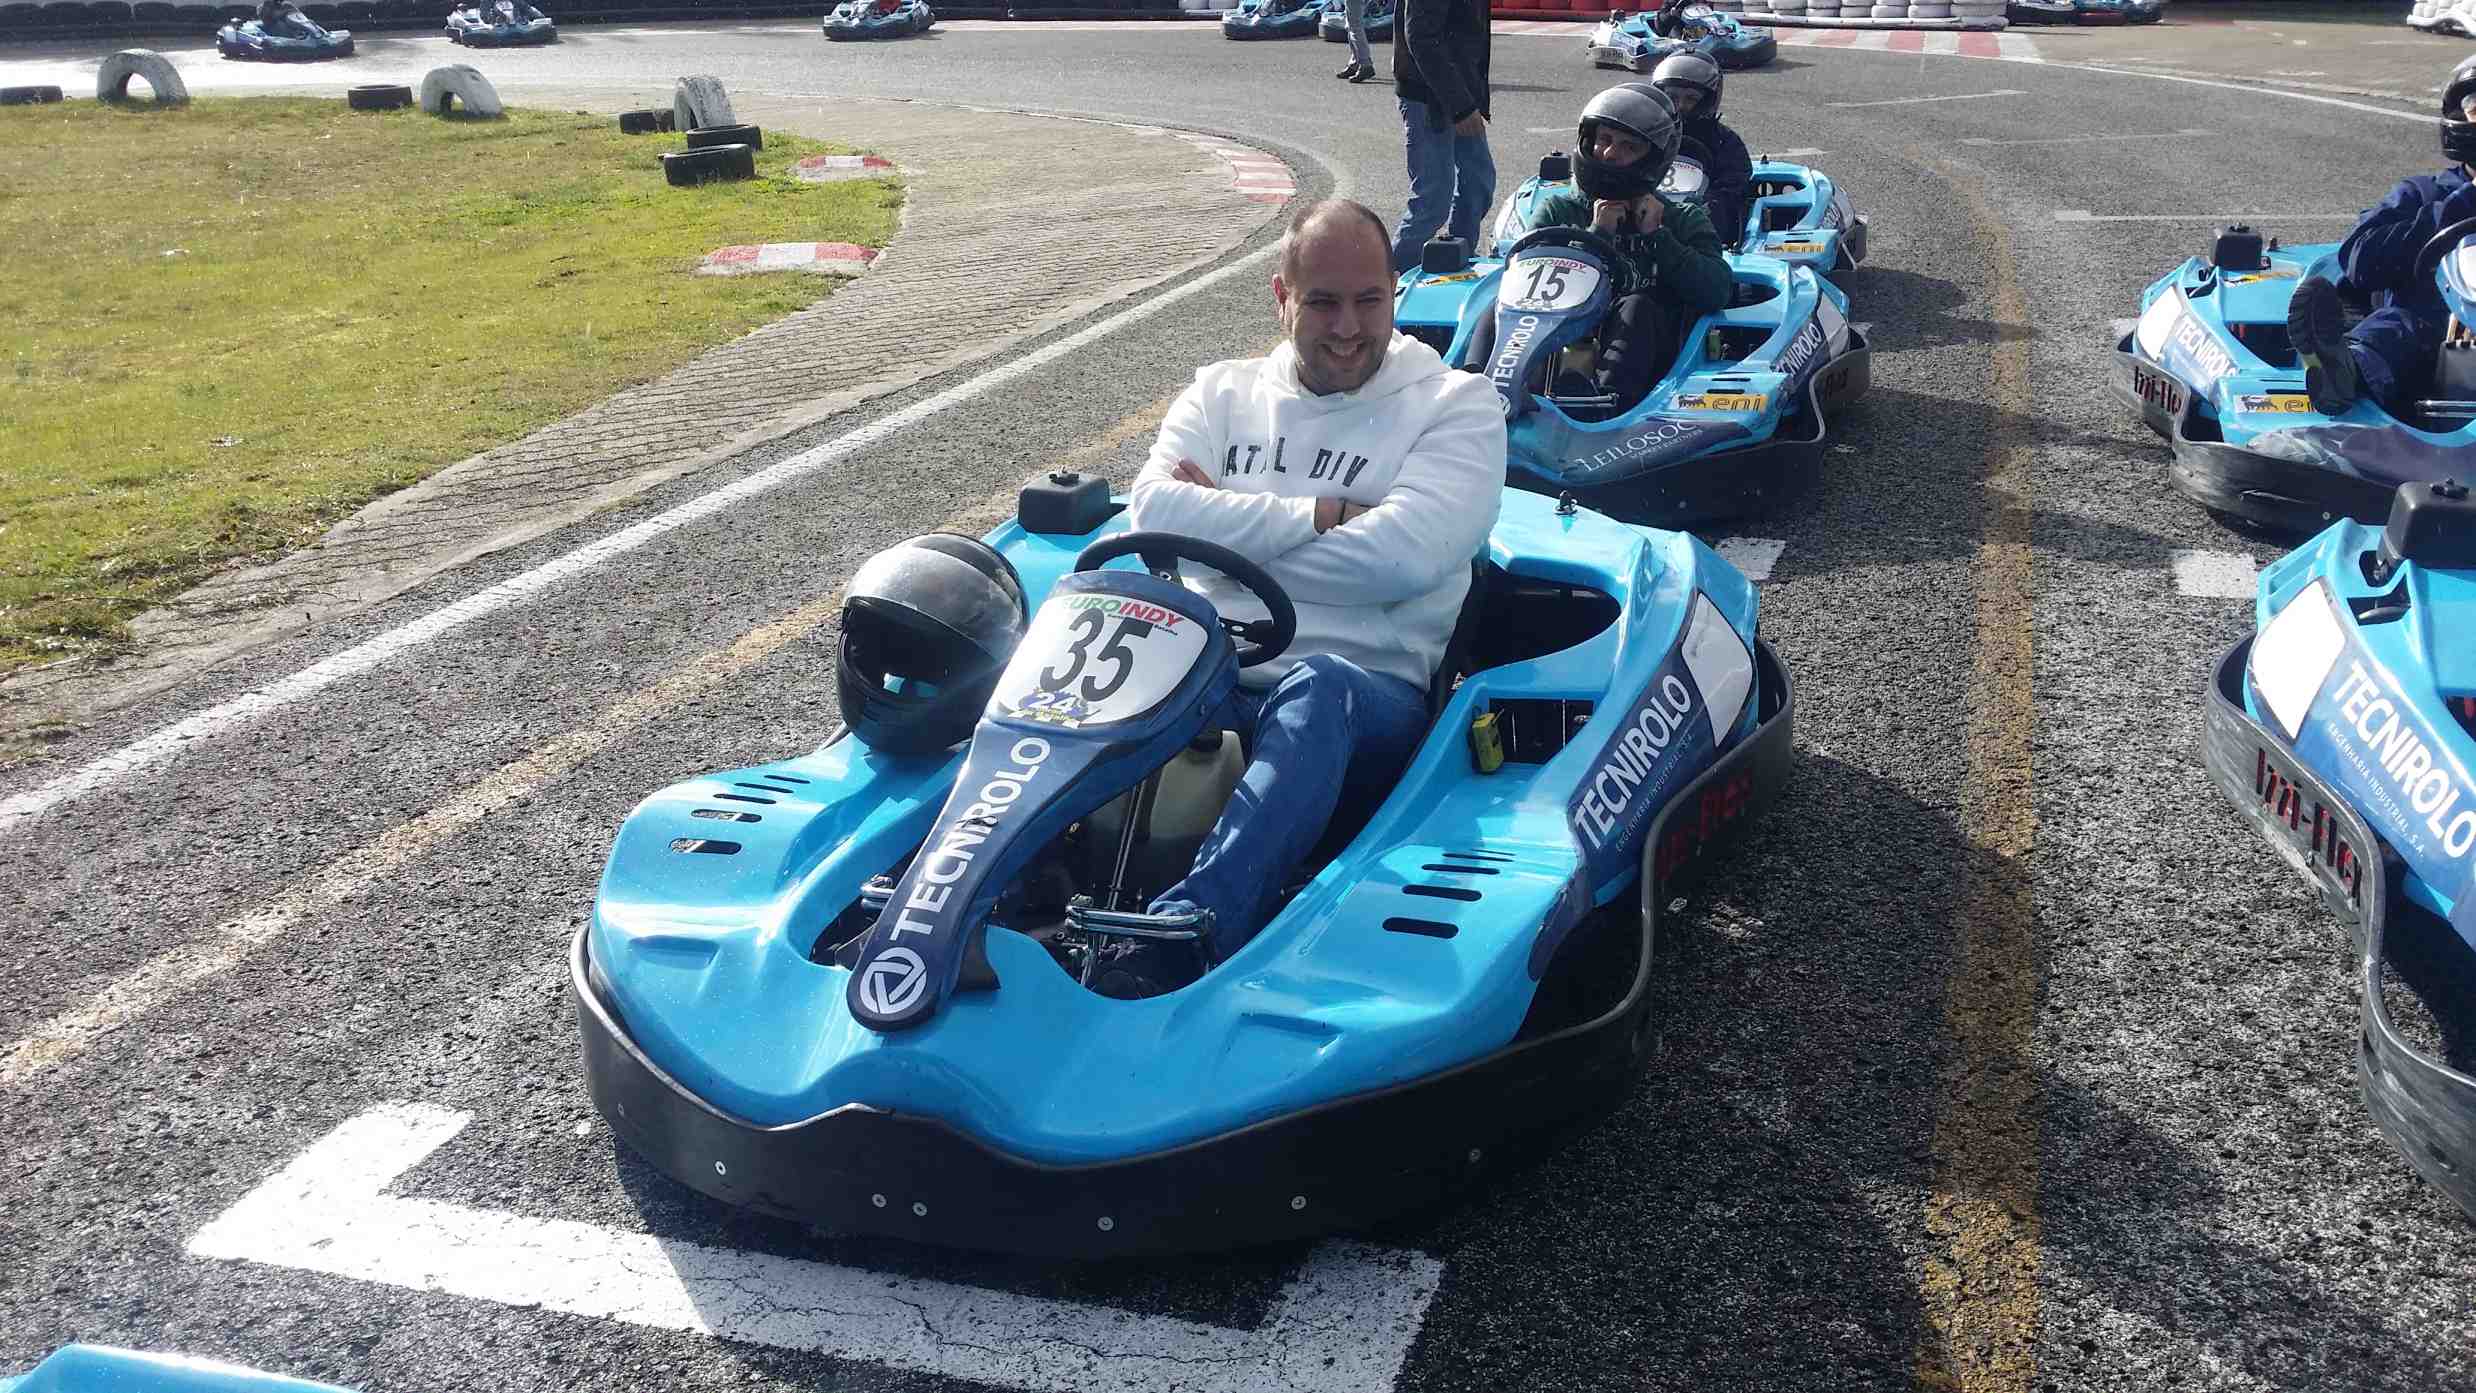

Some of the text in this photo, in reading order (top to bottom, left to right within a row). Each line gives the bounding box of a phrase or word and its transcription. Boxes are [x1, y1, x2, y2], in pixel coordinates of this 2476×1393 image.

[1526, 264, 1570, 301] 15
[1492, 315, 1539, 388] TECNIROLO
[1776, 321, 1822, 376] CNIROLO
[1039, 607, 1154, 702] 35
[1574, 674, 1692, 848] TECNIROLO
[2333, 660, 2476, 858] TECNIROLO
[889, 737, 1051, 940] TECNIROLO
